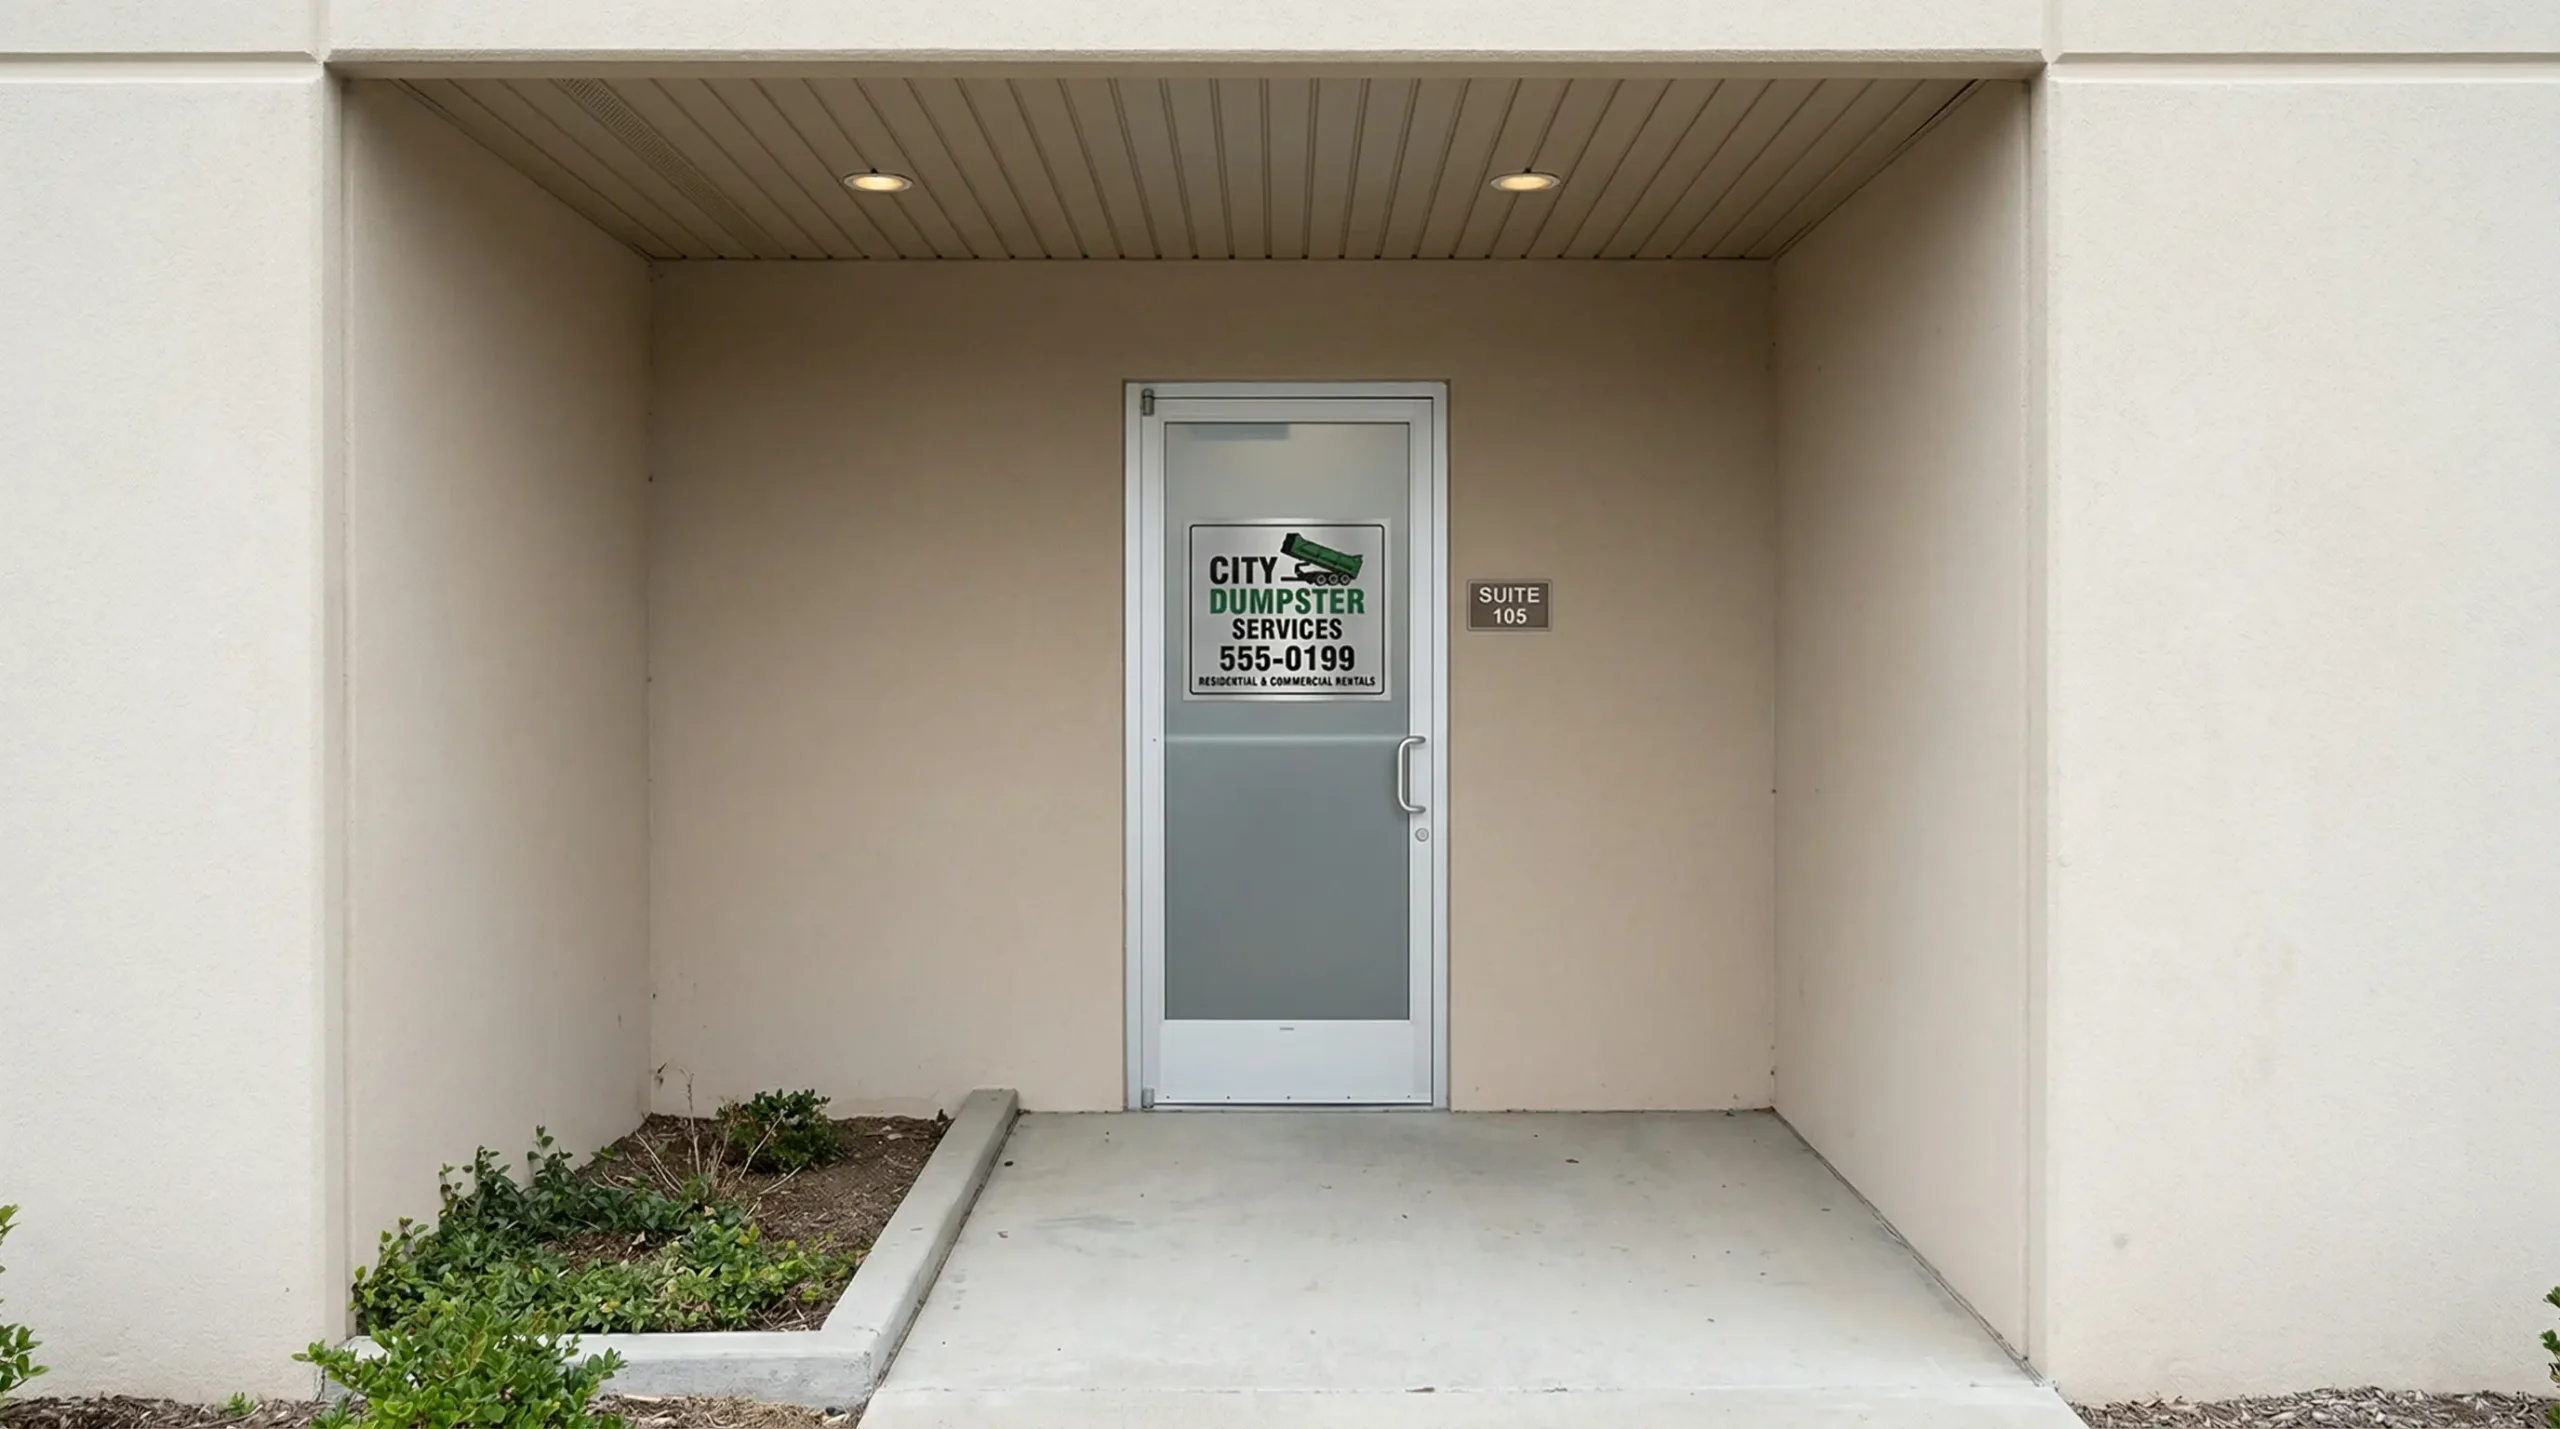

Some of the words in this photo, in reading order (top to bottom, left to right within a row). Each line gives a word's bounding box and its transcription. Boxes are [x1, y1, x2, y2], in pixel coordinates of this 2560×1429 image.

[1209, 555, 1278, 585] CITY
[1209, 588, 1365, 615] DUMPSTER
[1478, 586, 1540, 604] SUITE
[1492, 607, 1528, 625] 105
[1232, 617, 1343, 640] SERVICES
[1219, 645, 1355, 672] 555-0199
[1198, 676, 1257, 687] RESIDENTIAL
[1260, 676, 1267, 687] &
[1270, 676, 1333, 687] COMMERCIAL
[1335, 676, 1376, 687] RENTALS
